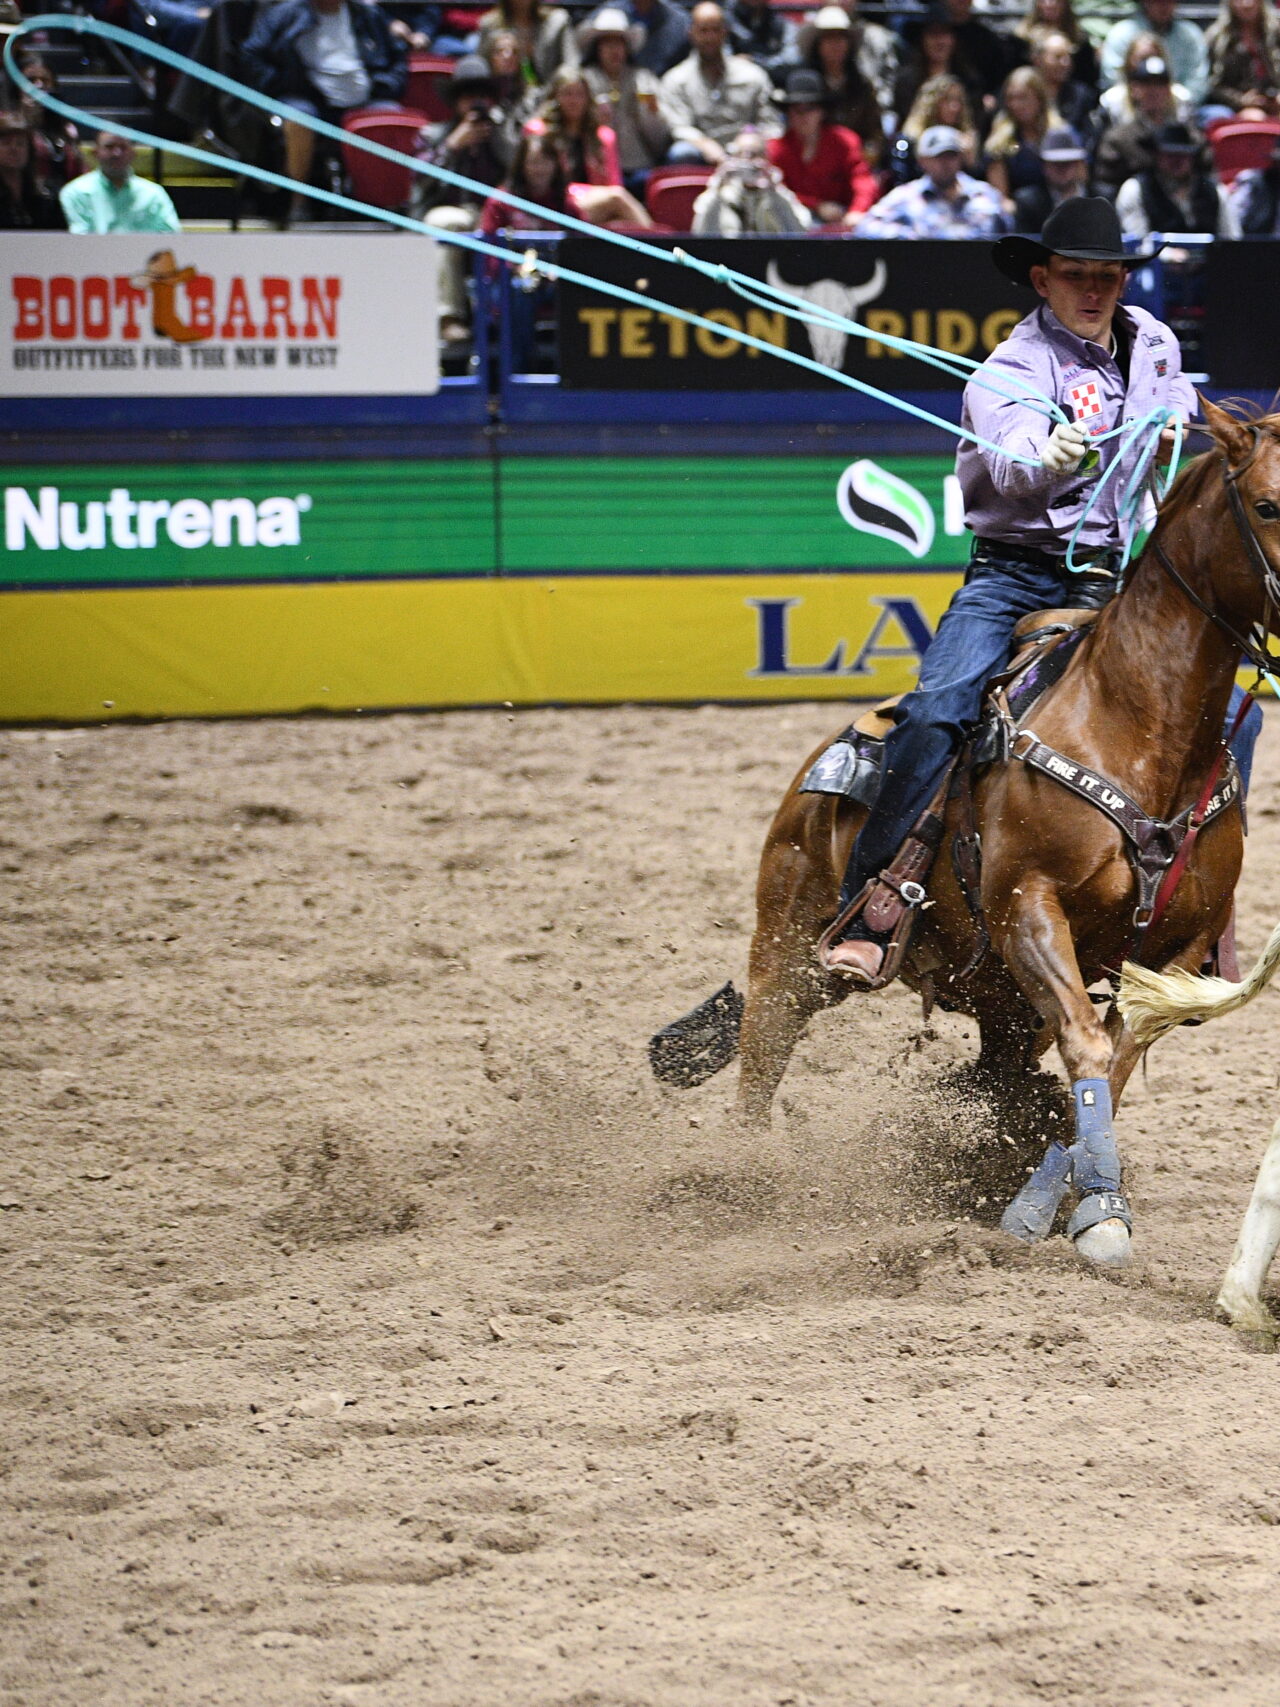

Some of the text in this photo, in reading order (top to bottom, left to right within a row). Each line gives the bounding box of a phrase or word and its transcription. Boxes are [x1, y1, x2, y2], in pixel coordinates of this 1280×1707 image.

[12, 275, 342, 341] BOOT BARN
[578, 308, 1022, 358] TETON RIDG
[13, 345, 339, 370] OUTFITTERS FOR THE NEW WEST
[4, 486, 304, 551] Nutrena
[1046, 755, 1126, 811] FIRE IT UP
